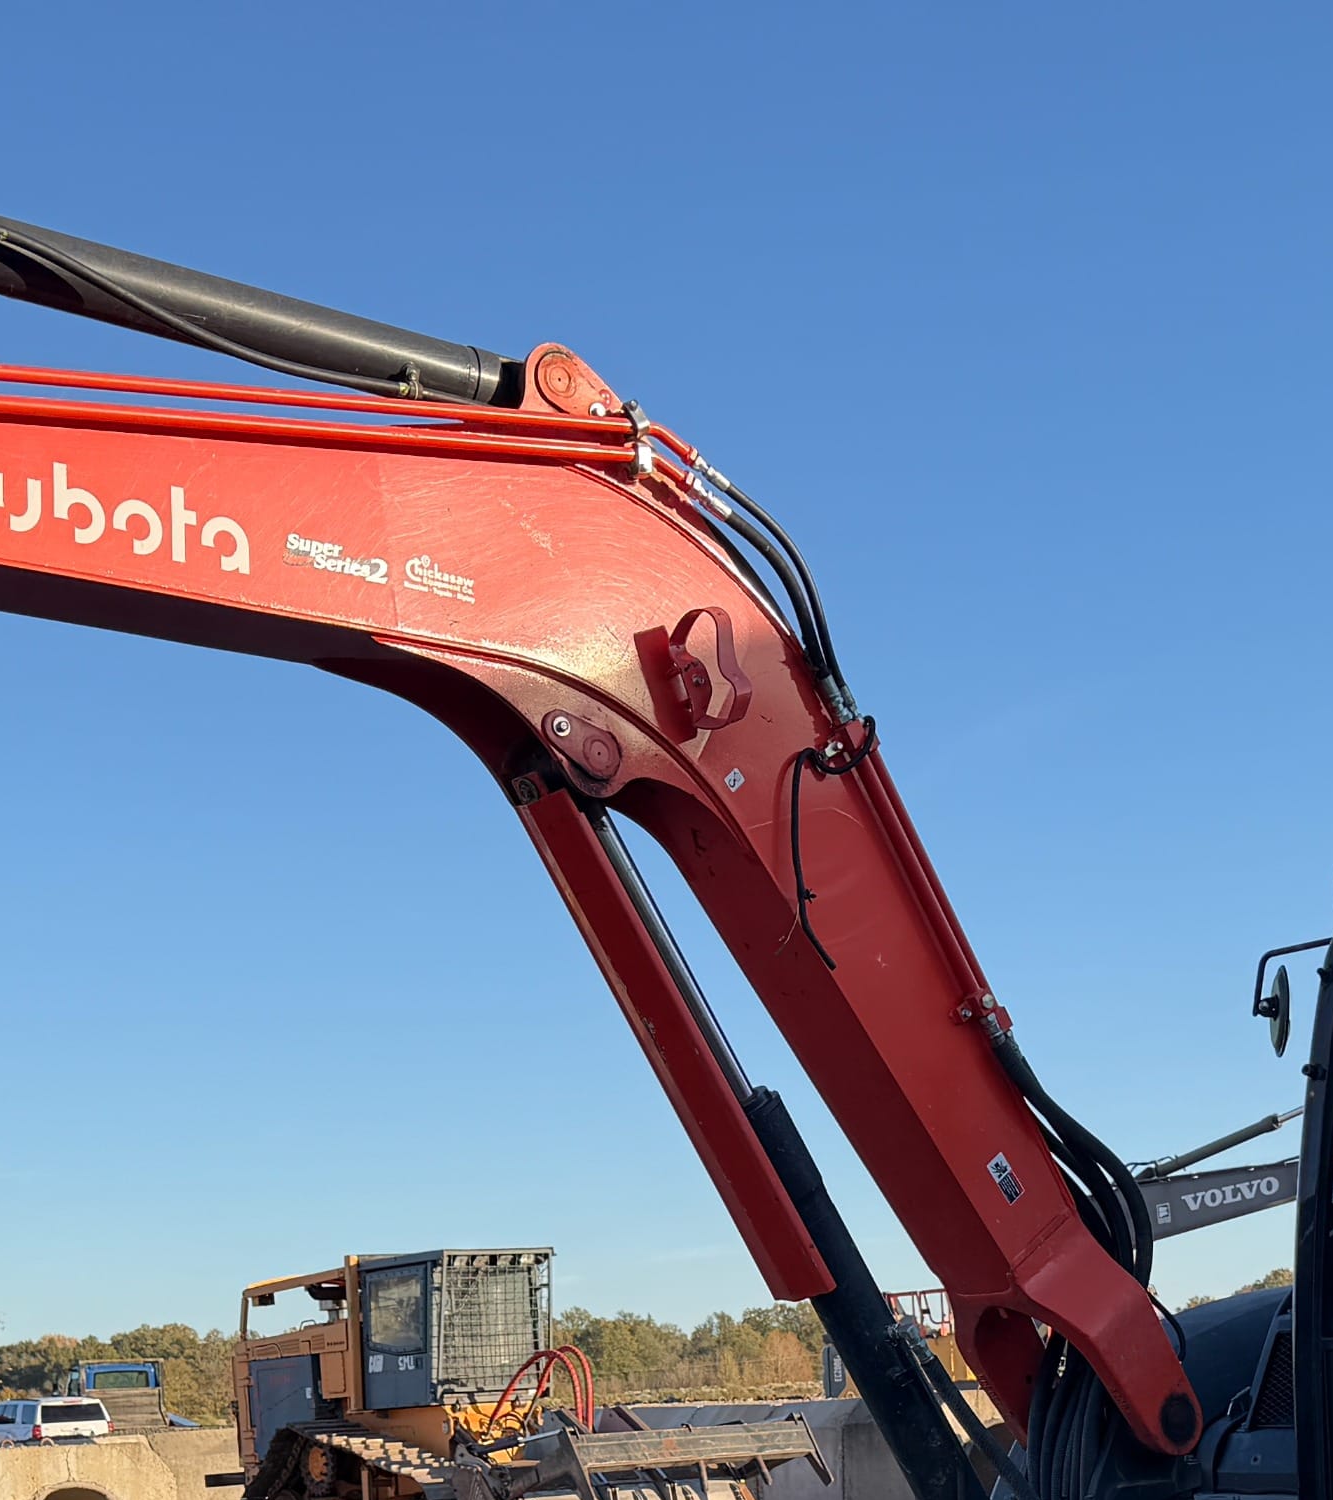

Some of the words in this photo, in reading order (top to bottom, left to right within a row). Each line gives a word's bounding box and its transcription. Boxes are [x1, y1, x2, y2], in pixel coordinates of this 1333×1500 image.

[286, 533, 343, 557] Super
[404, 554, 475, 588] Chickasaw
[1181, 1176, 1280, 1212] VOLVO
